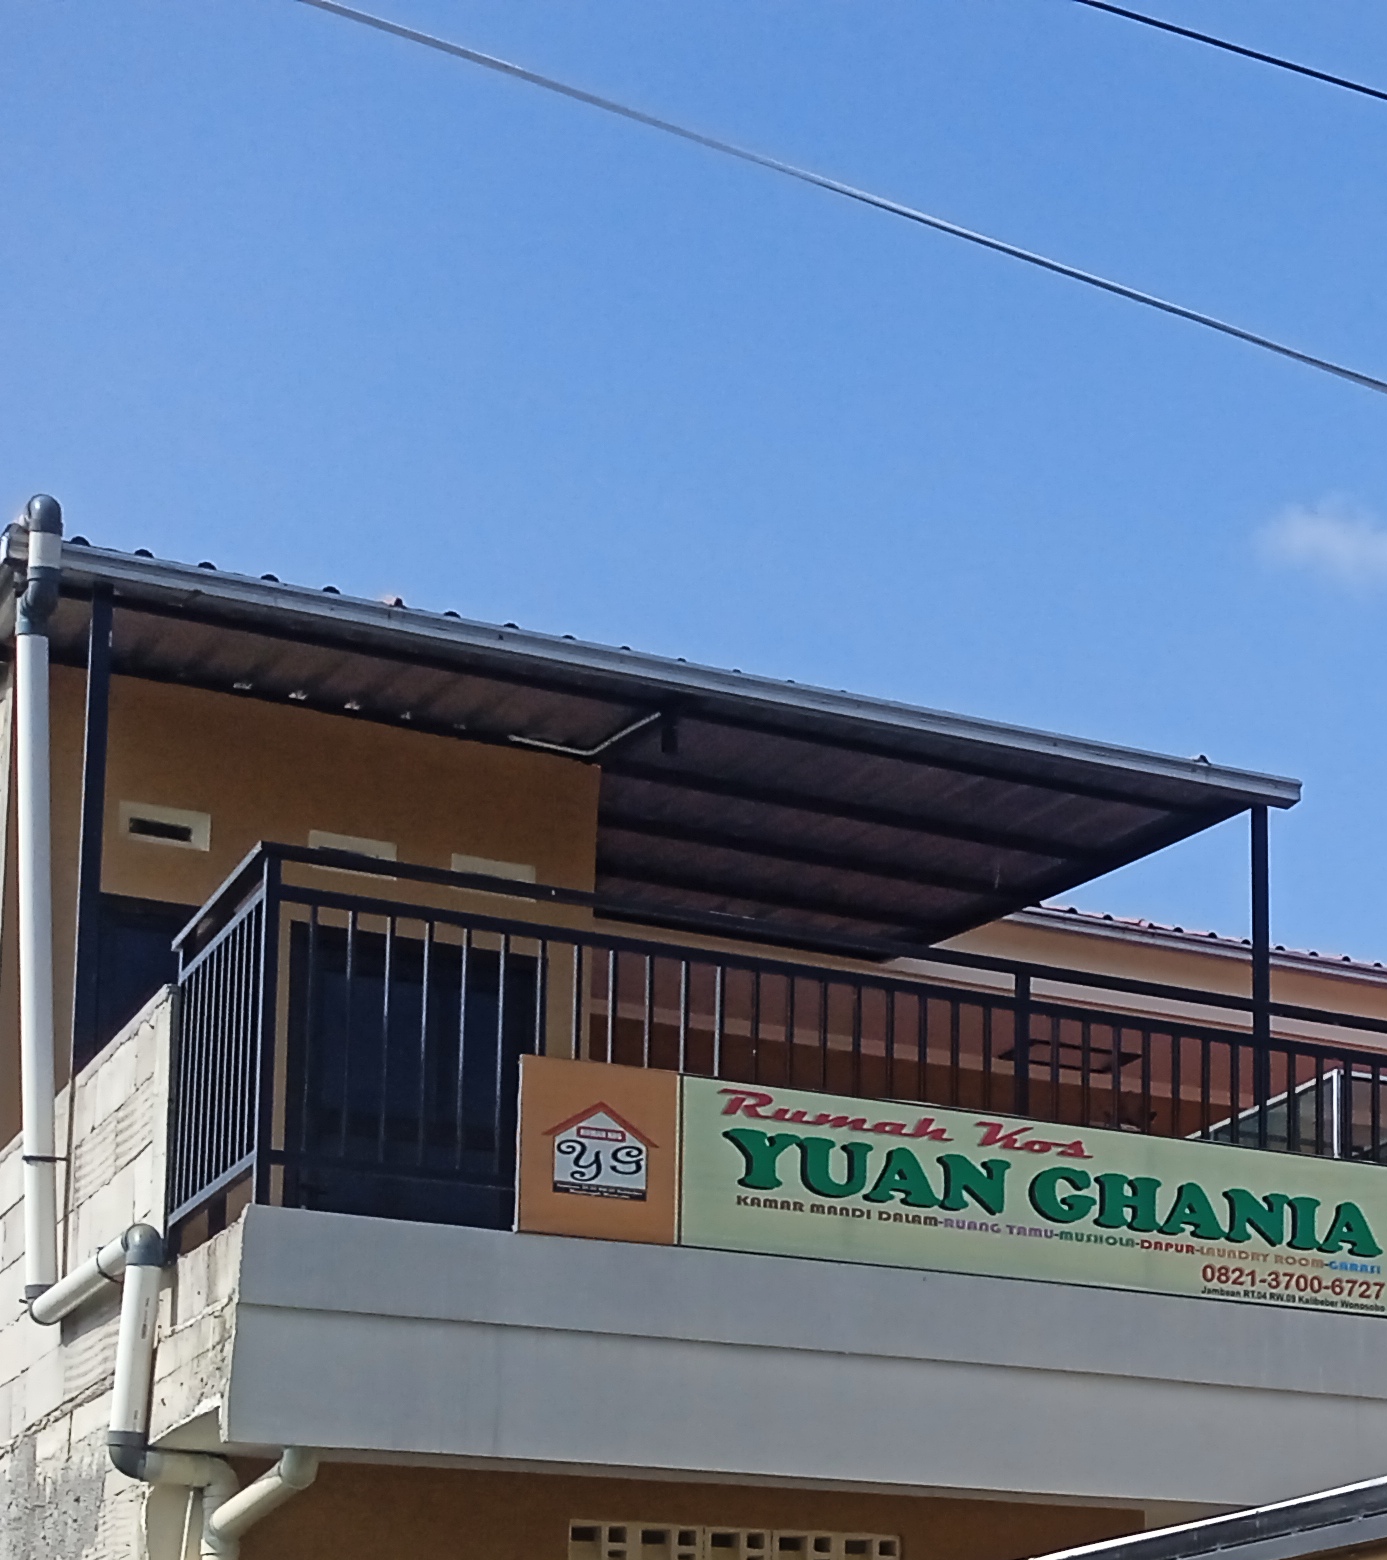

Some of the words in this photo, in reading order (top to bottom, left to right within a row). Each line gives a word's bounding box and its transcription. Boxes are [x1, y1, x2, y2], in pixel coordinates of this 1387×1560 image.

[717, 1088, 954, 1142] Rumah
[975, 1120, 1094, 1159] Kos
[722, 1128, 1012, 1216] YUAN
[1028, 1166, 1383, 1258] GHANIA
[736, 1195, 804, 1213] KAMAR
[810, 1202, 872, 1220] MANDI
[1201, 1263, 1386, 1301] 0821-3700-6727
[1340, 1299, 1386, 1313] Wonosobo
